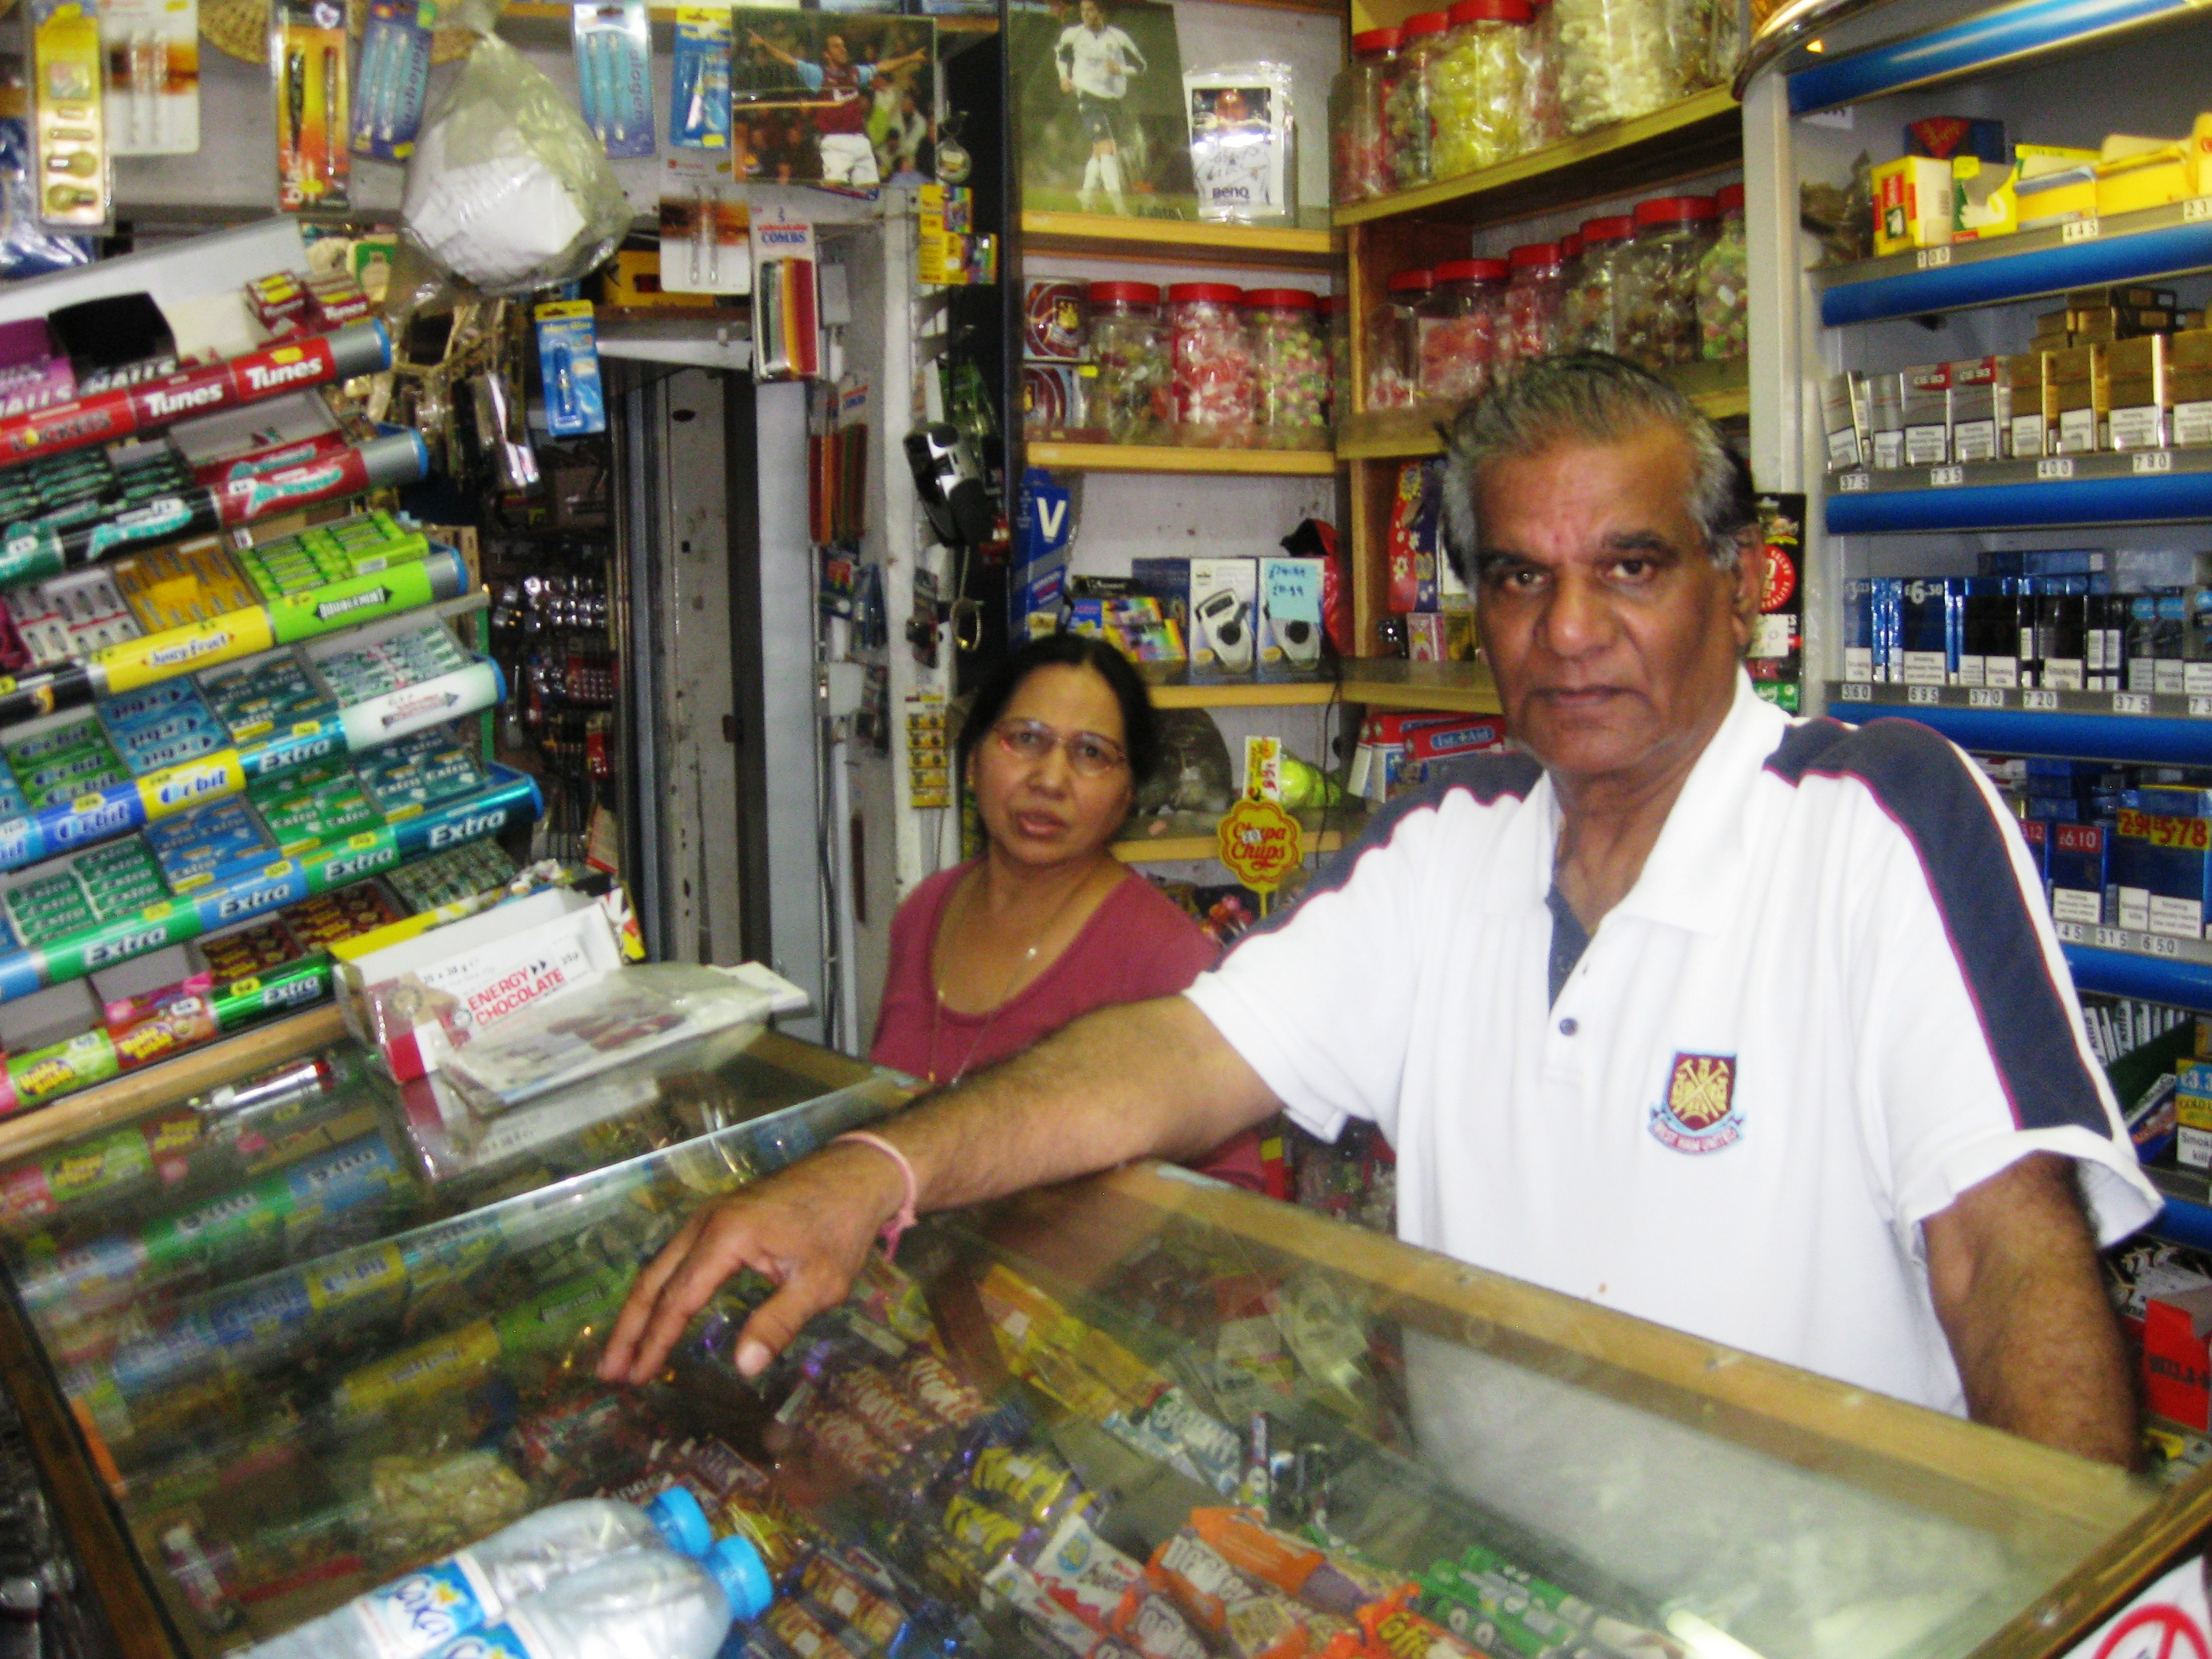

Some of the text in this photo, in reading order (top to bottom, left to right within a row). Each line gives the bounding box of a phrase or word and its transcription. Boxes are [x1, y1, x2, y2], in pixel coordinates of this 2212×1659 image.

[760, 231, 806, 244] COMBS
[246, 358, 323, 390] Tunes
[144, 384, 224, 417] Tunes
[259, 739, 331, 773] Extra
[160, 768, 226, 804] Orbit
[430, 808, 507, 848] Extra
[1233, 822, 1286, 841] Cpa
[324, 847, 394, 882] Extra
[219, 884, 291, 918] Extra
[84, 926, 168, 968] Extra
[263, 975, 319, 1006] Extra
[467, 967, 530, 1011] ENERGY
[474, 968, 565, 1027] CHOCOLATE
